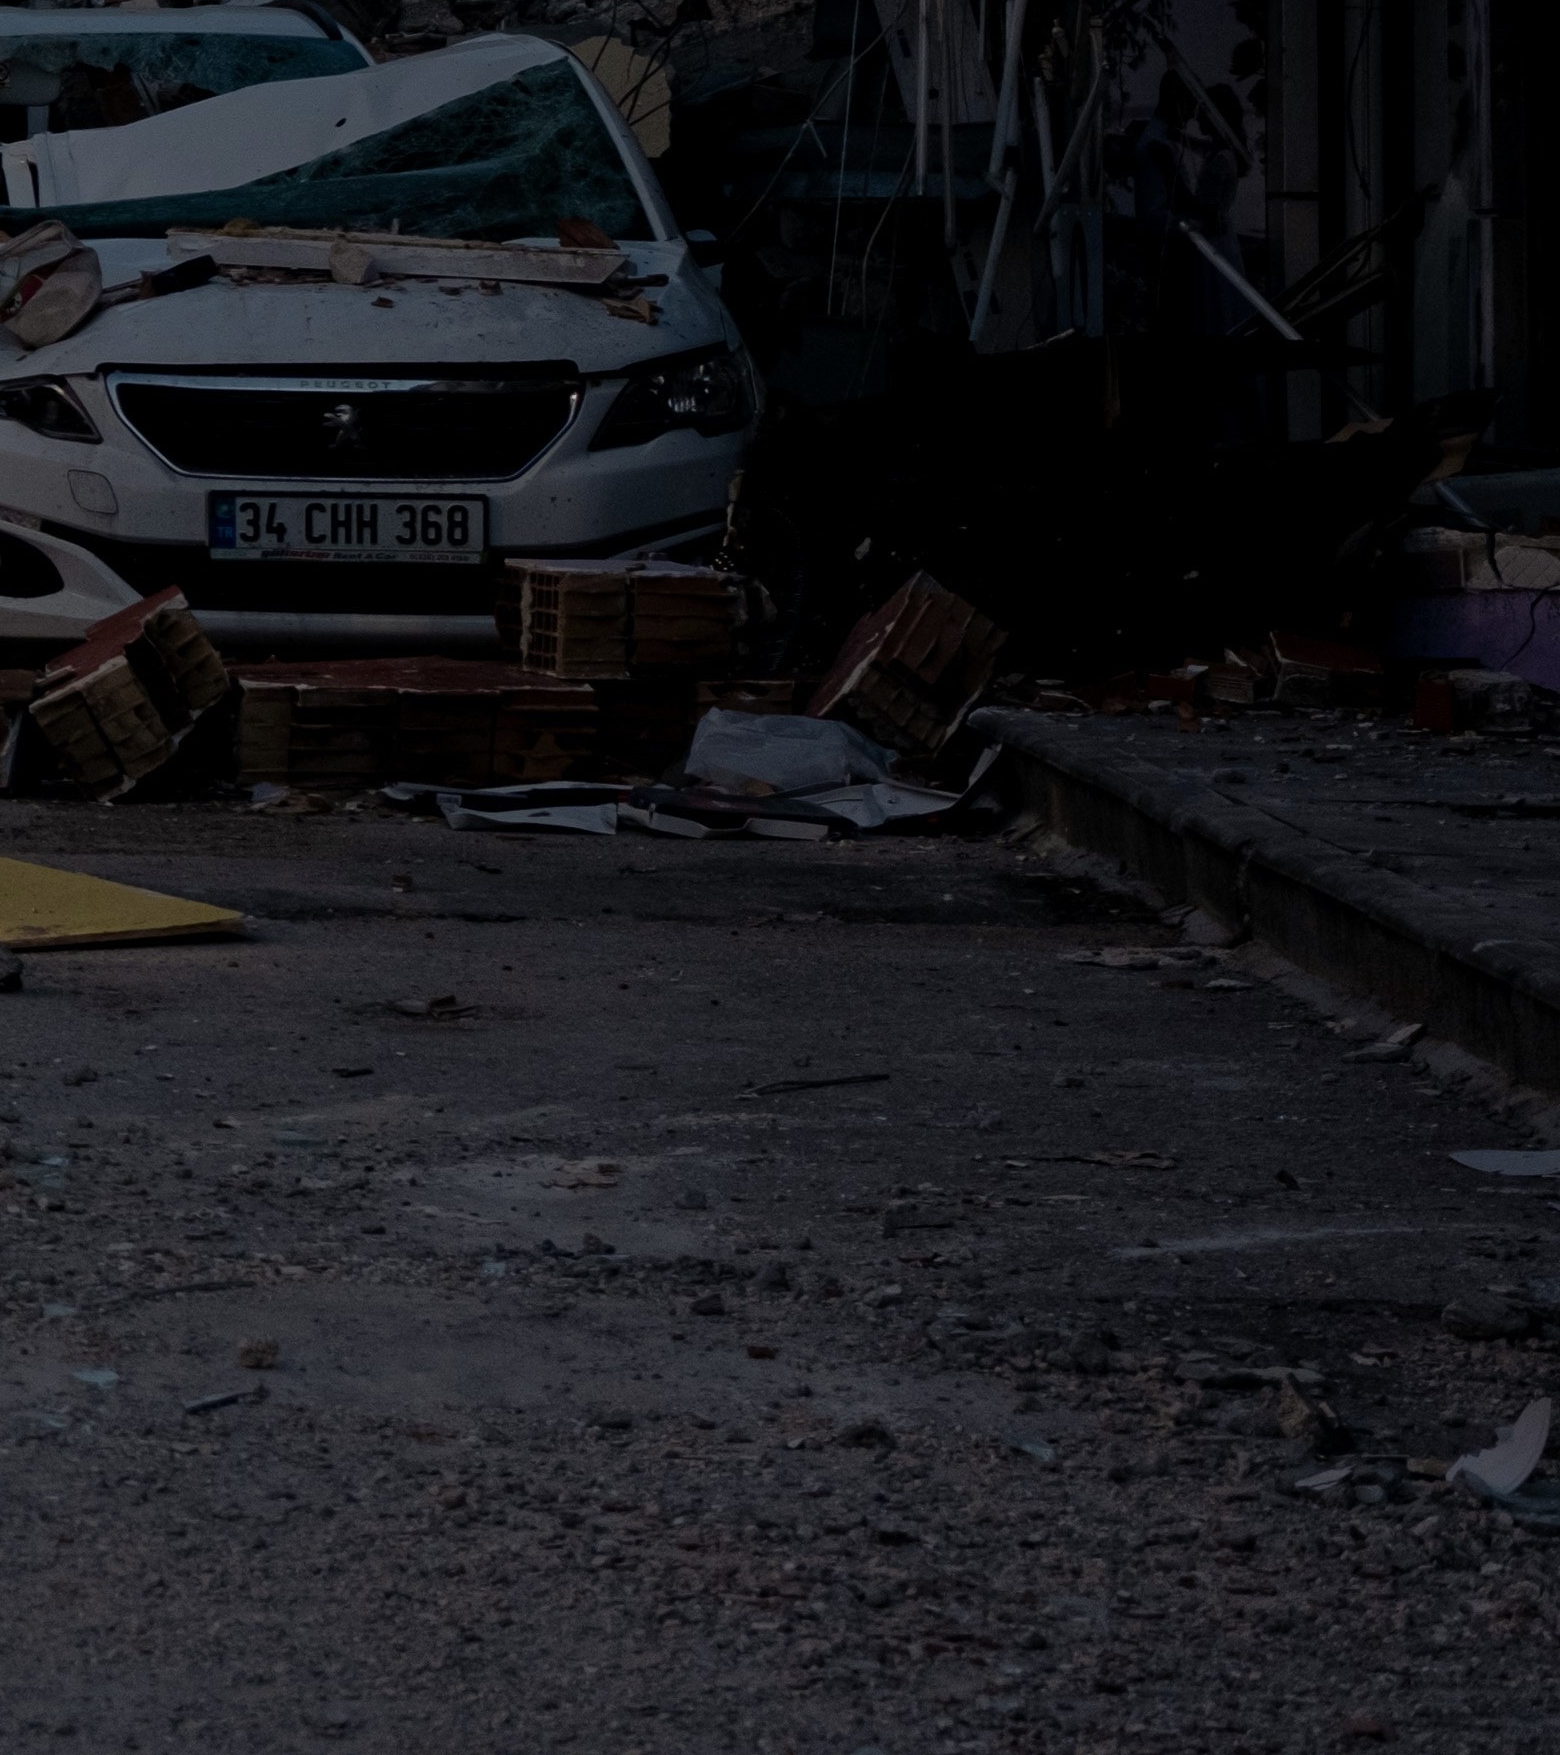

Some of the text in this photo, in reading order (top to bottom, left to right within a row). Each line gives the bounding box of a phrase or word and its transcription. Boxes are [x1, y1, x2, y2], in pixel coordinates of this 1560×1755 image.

[299, 380, 392, 390] PEUGEOT
[217, 502, 469, 546] TR 34 CHH 368
